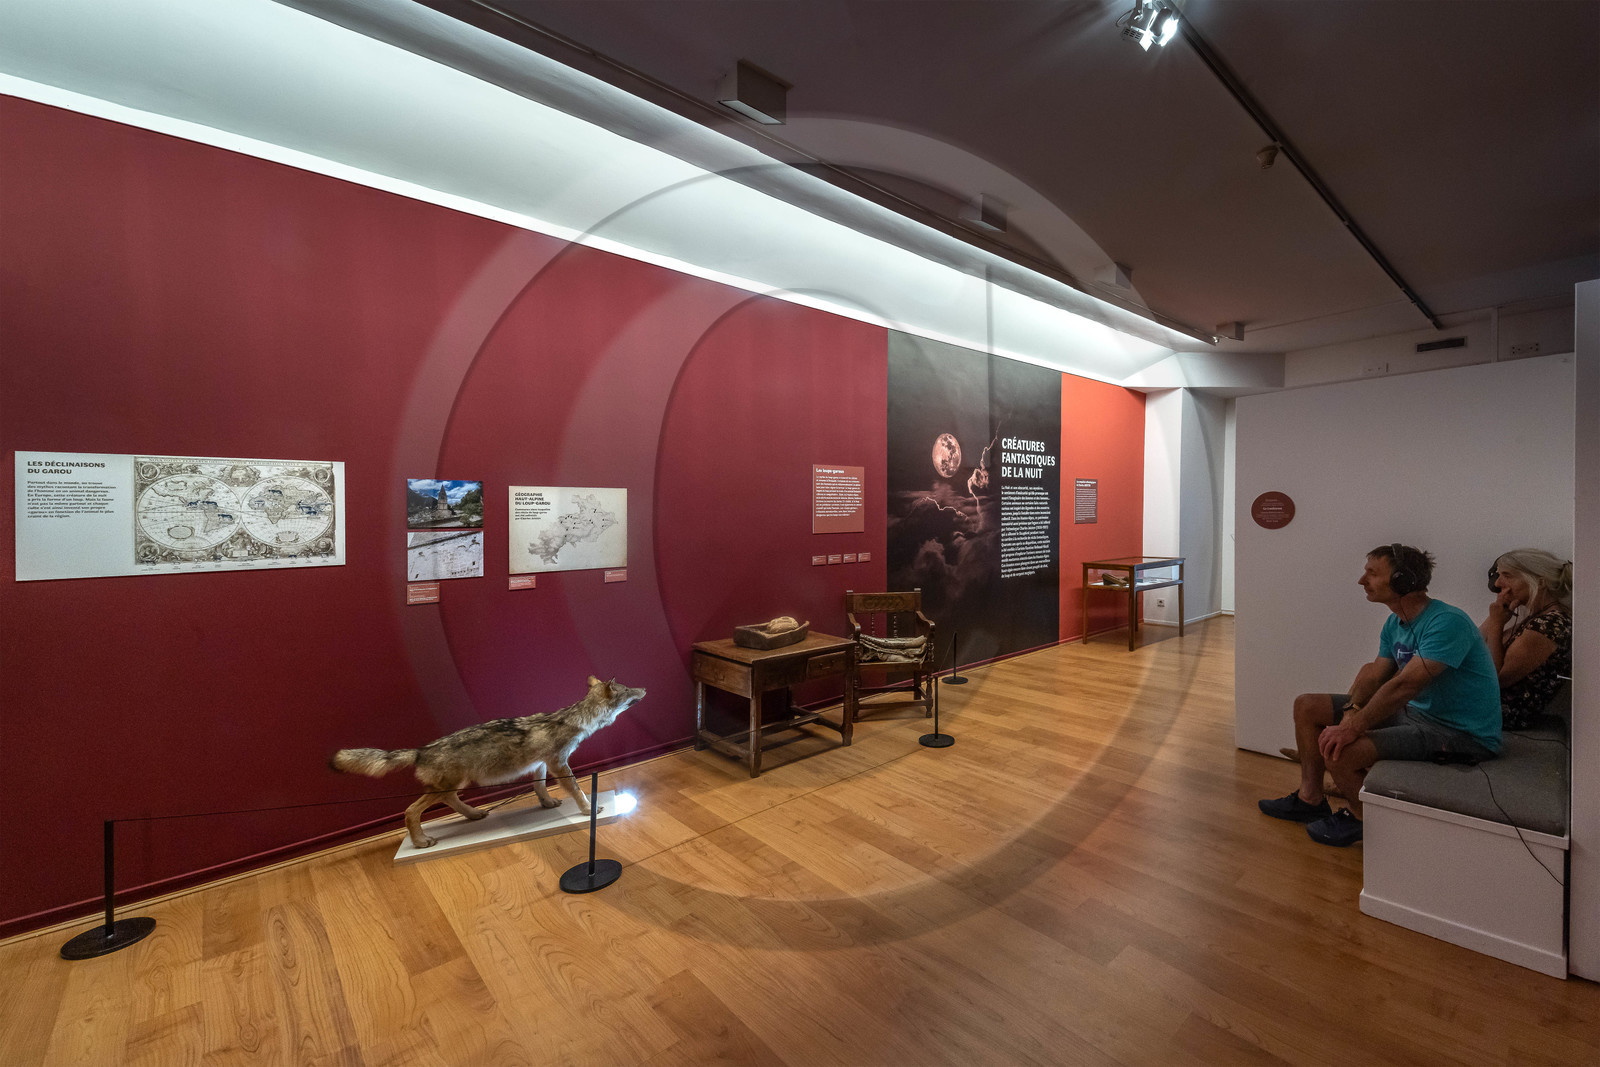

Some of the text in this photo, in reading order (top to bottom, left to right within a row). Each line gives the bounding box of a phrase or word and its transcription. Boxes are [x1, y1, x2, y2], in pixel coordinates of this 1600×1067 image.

[1002, 436, 1045, 452] CRÉATURES
[1002, 452, 1055, 467] FANTASTIQUES
[1002, 466, 1043, 478] DE LA NUIT
